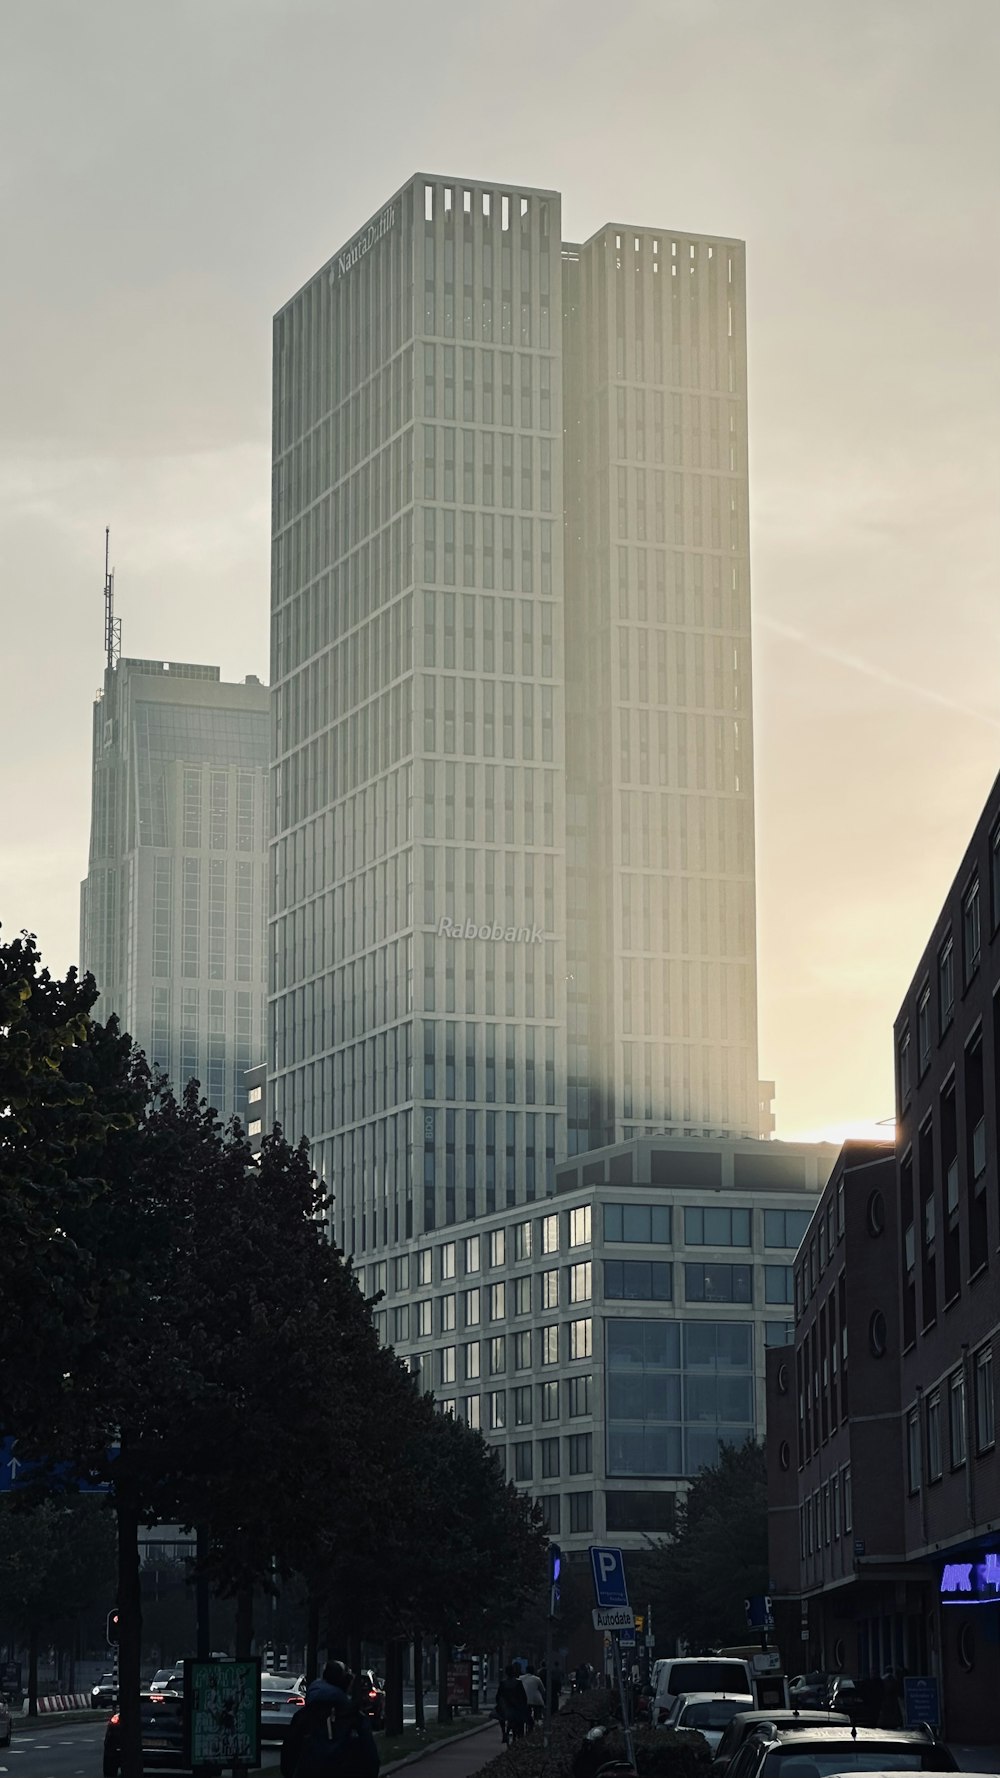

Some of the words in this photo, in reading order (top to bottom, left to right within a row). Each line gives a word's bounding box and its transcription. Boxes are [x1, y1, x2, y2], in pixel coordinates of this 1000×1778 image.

[338, 205, 395, 278] NautaDutilh
[437, 916, 544, 944] Rabobank
[425, 1115, 433, 1138] BDO
[598, 1552, 616, 1582] P
[597, 1611, 631, 1626] Autodate
